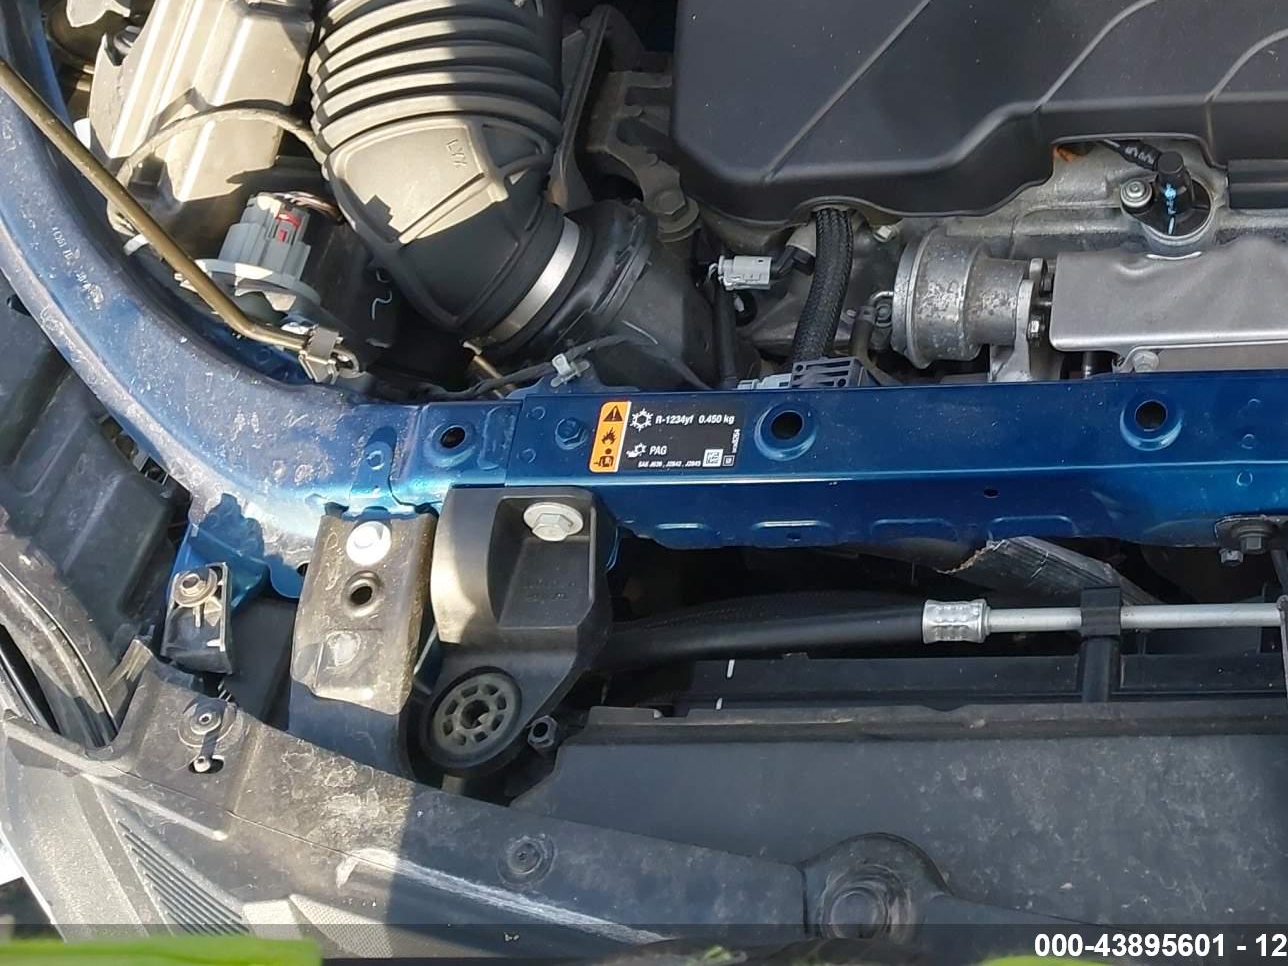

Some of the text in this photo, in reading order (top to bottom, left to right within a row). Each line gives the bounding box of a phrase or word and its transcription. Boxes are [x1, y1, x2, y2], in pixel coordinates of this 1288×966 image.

[655, 414, 735, 426] R-1234yf 0.450 kg
[649, 445, 667, 455] PAG
